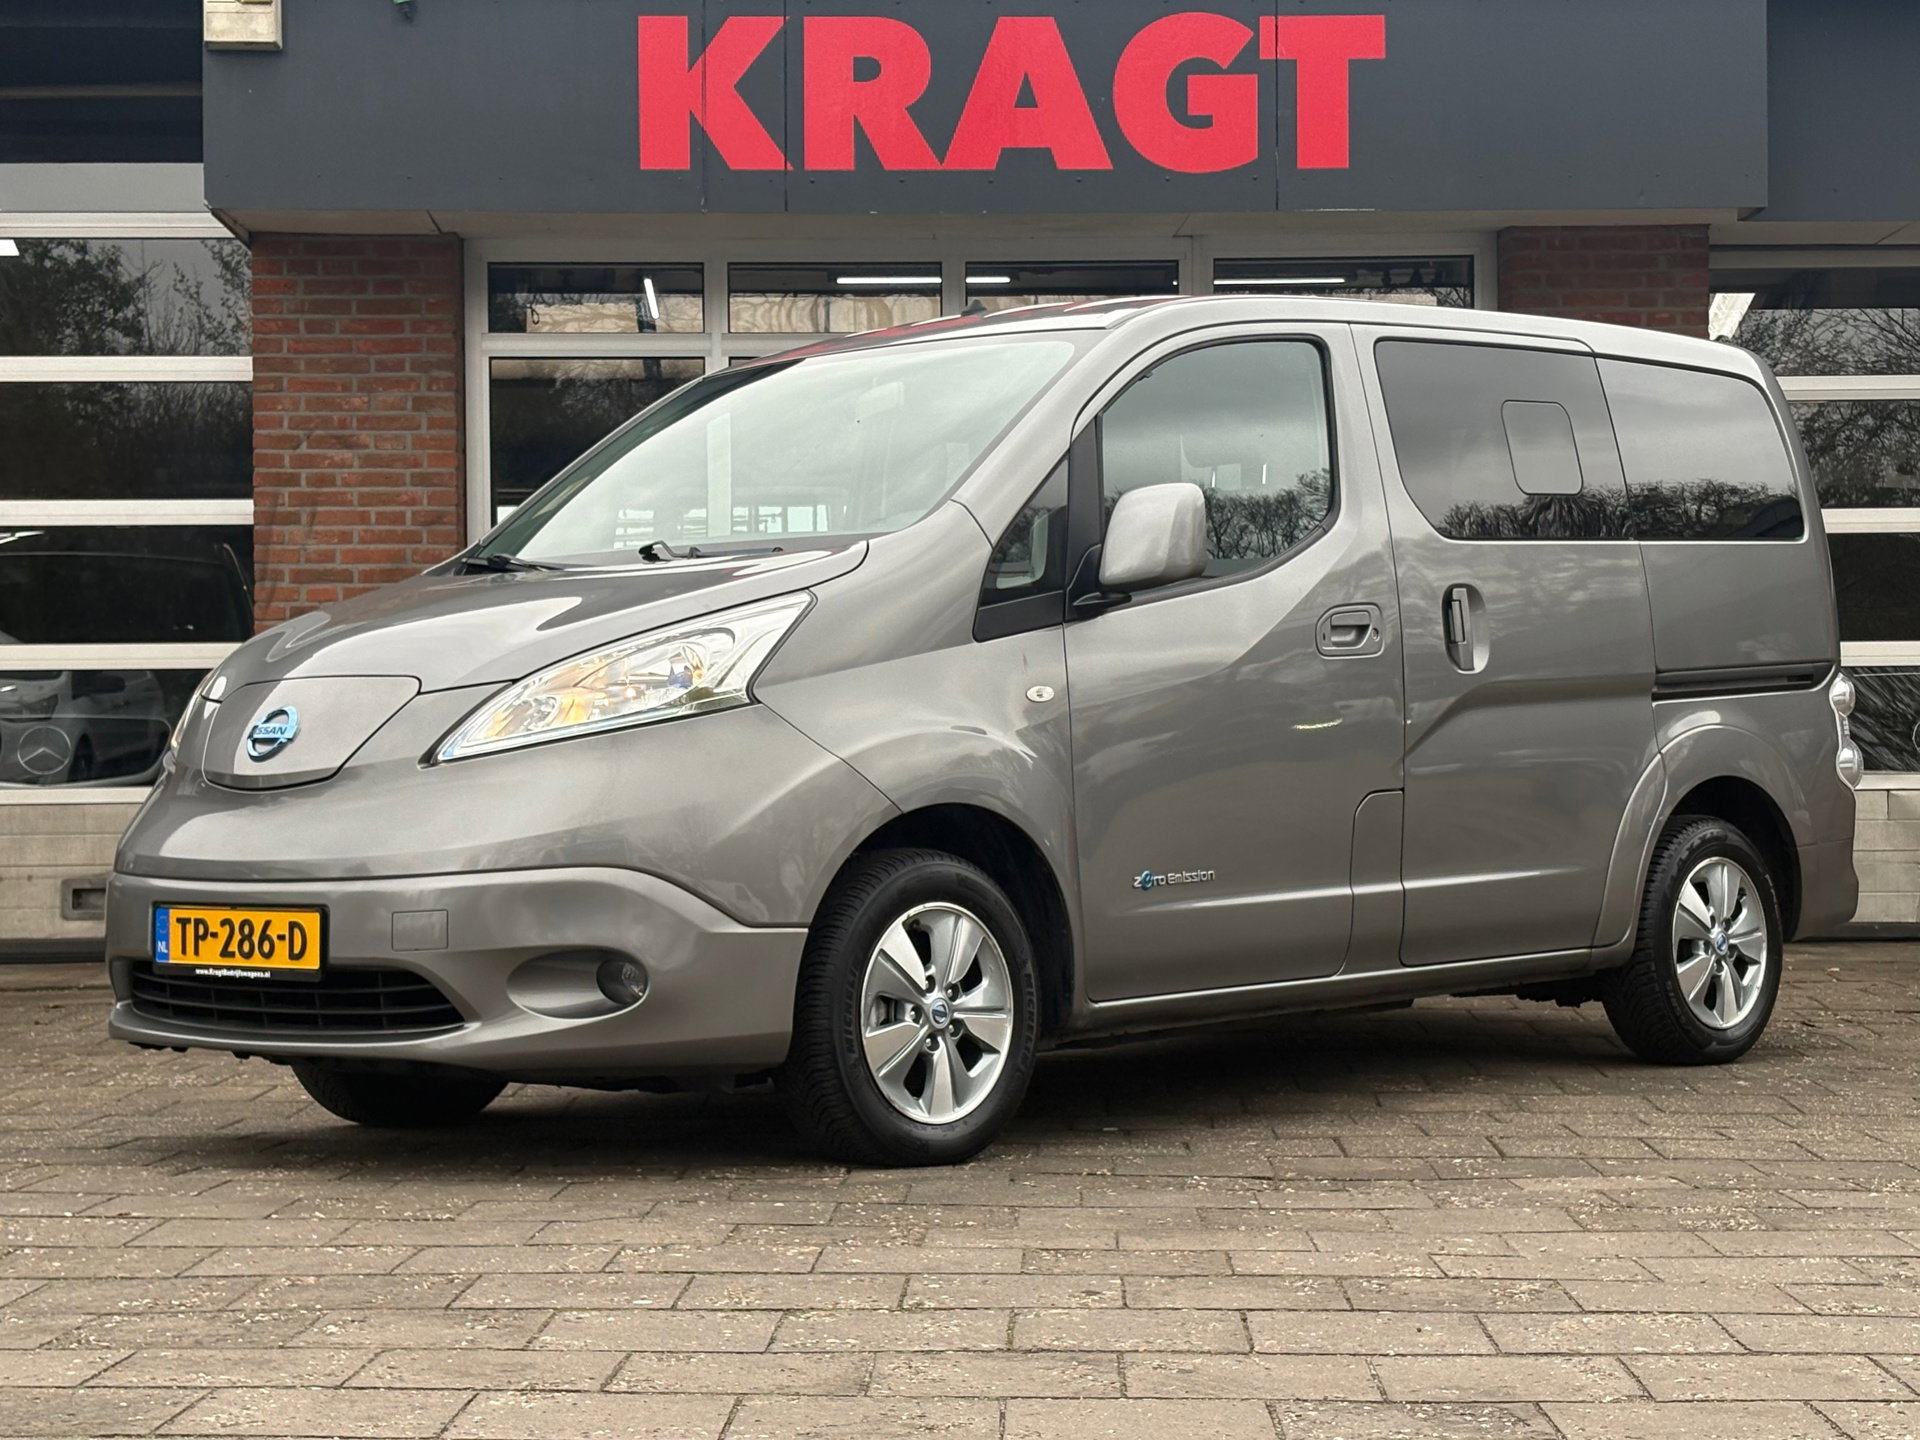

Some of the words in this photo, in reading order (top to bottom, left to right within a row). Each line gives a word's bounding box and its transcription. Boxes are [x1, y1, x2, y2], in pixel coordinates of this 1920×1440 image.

[638, 12, 1386, 173] KRAGT
[1167, 869, 1215, 884] Emission
[158, 940, 168, 954] NL
[176, 916, 307, 961] TP-286-D
